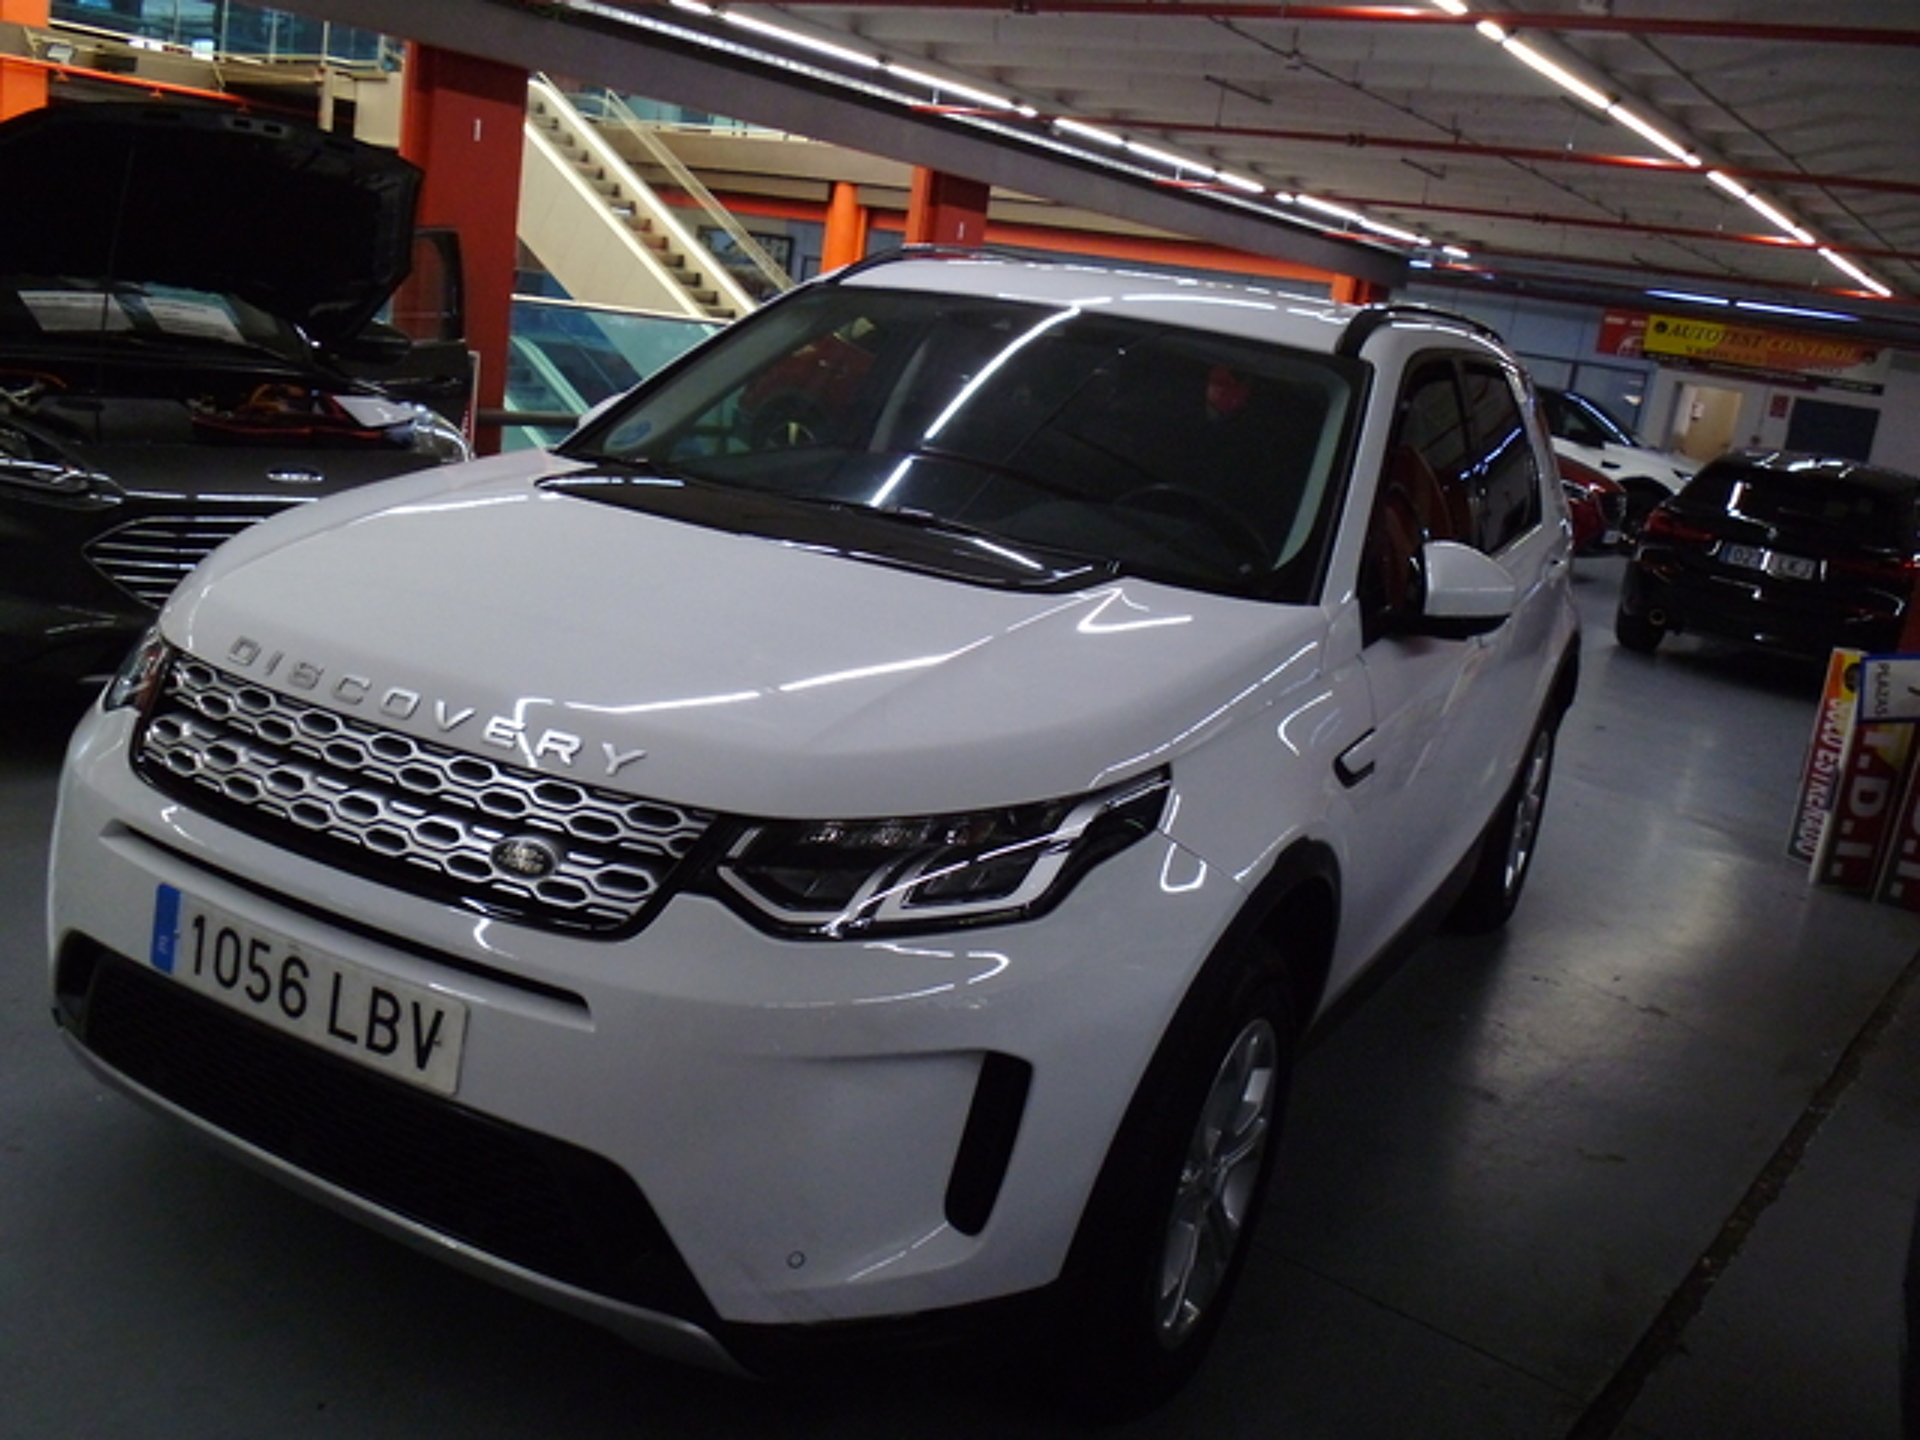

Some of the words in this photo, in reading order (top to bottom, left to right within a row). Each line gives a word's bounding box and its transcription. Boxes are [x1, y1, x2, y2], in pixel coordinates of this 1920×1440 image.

[227, 636, 646, 777] DISCOVERY
[1874, 662, 1891, 717] PLAZAS
[192, 914, 309, 1019] 1056
[327, 971, 444, 1071] LBV
